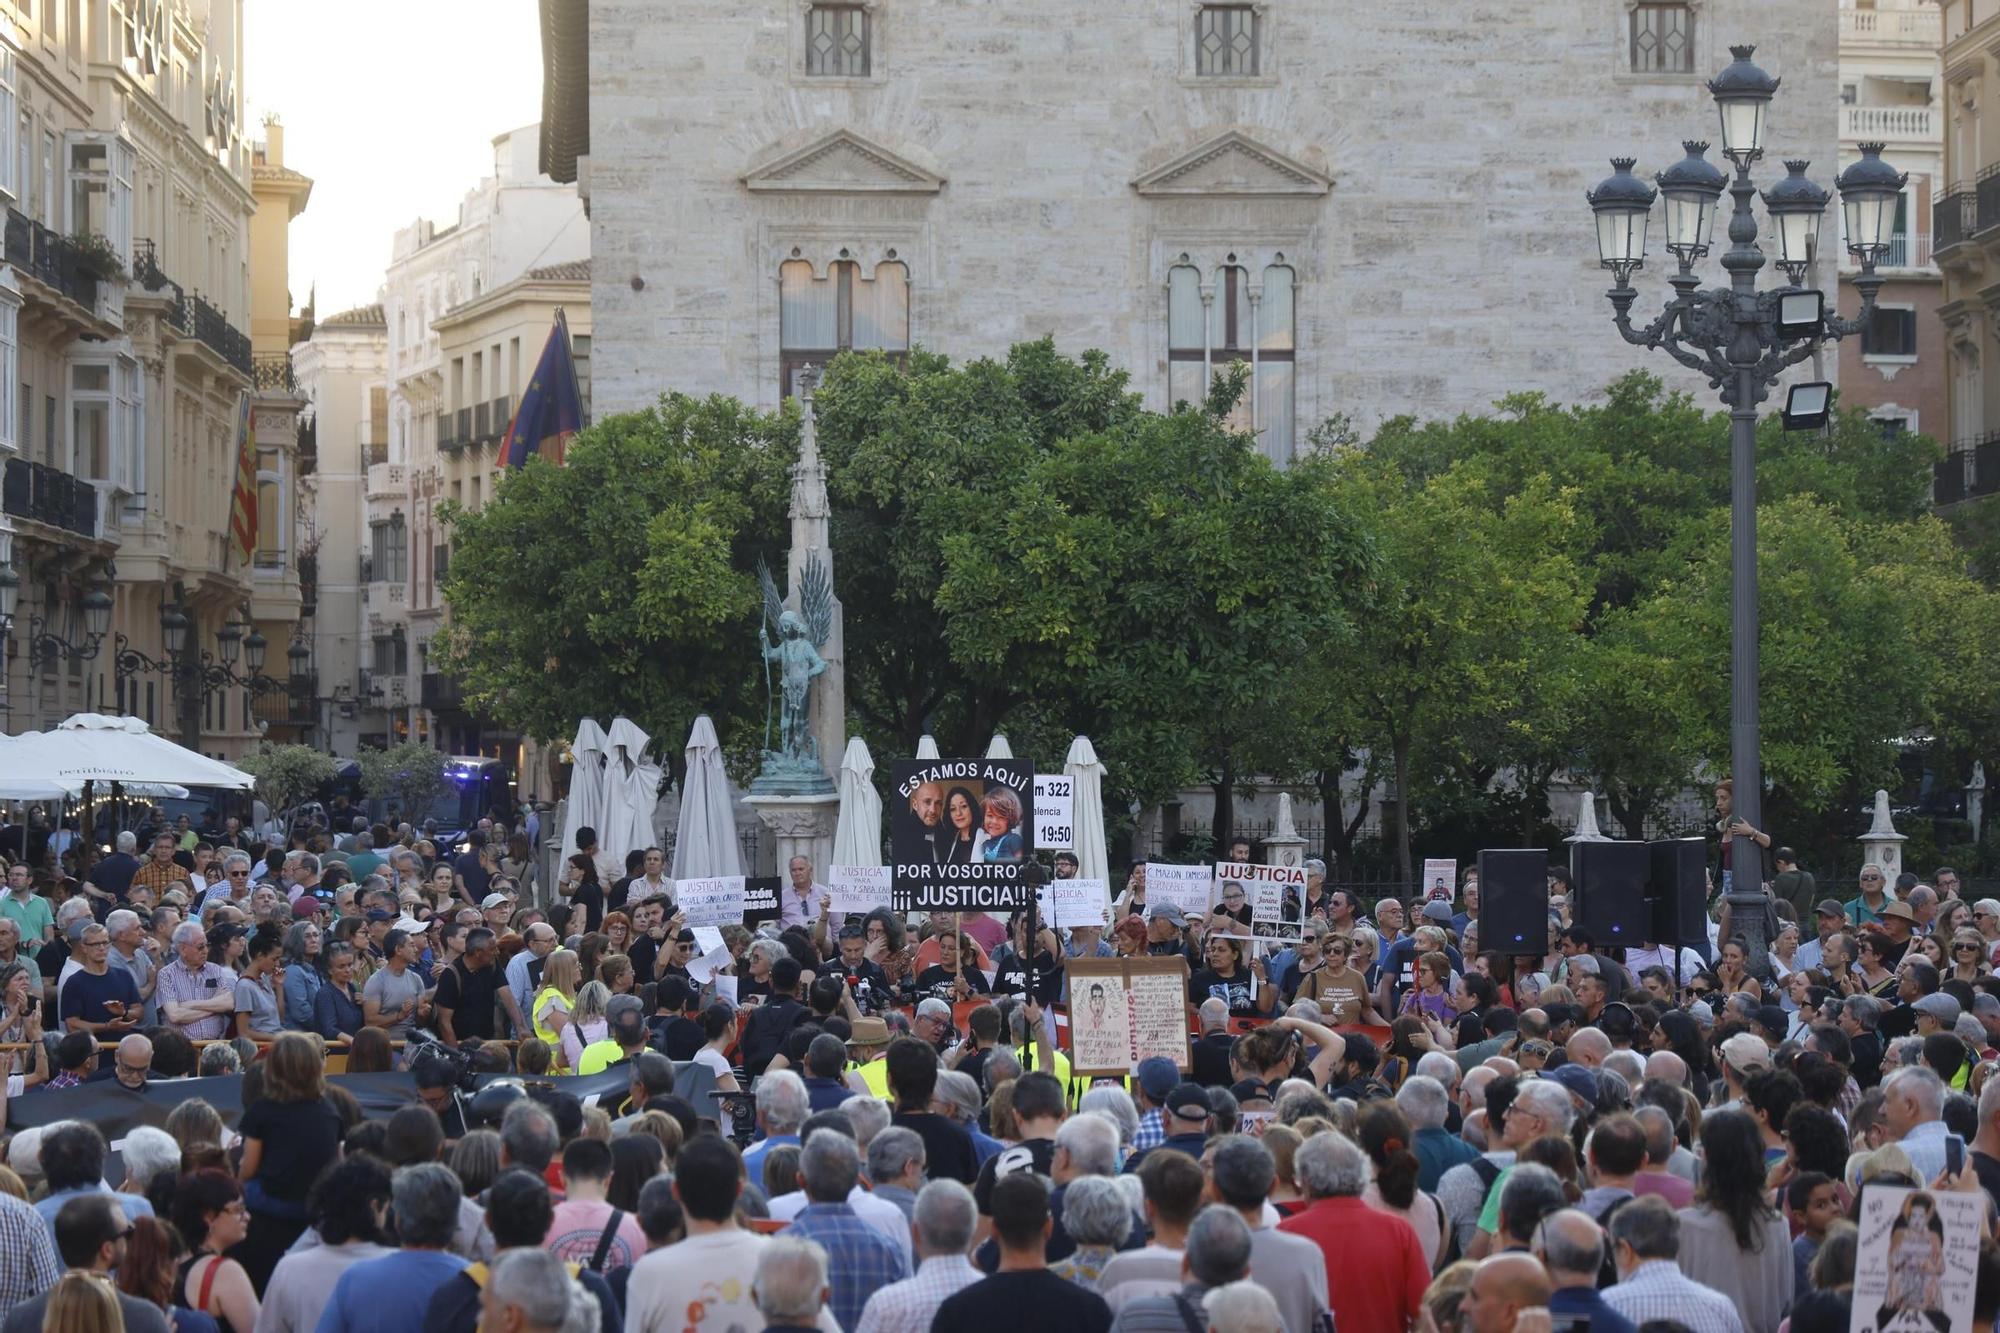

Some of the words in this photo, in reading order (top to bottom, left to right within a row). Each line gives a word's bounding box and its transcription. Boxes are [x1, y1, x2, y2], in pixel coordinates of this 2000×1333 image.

[899, 763, 977, 798] ESTAMOS
[983, 765, 1029, 792] AQUÍ
[1034, 785, 1044, 797] m
[1048, 782, 1070, 797] 322
[1034, 806, 1061, 816] alencia
[1041, 826, 1071, 842] 19:50
[842, 867, 883, 877] JUSTICIA
[897, 865, 931, 879] POR
[1219, 865, 1305, 884] JUSTICIA
[686, 880, 724, 893] JUSTICIA
[745, 888, 773, 900] AZÓN
[916, 885, 1030, 906] JUSTICIA!!
[743, 898, 778, 910] MISSIÓ
[1080, 1057, 1120, 1066] PRESIDENT
